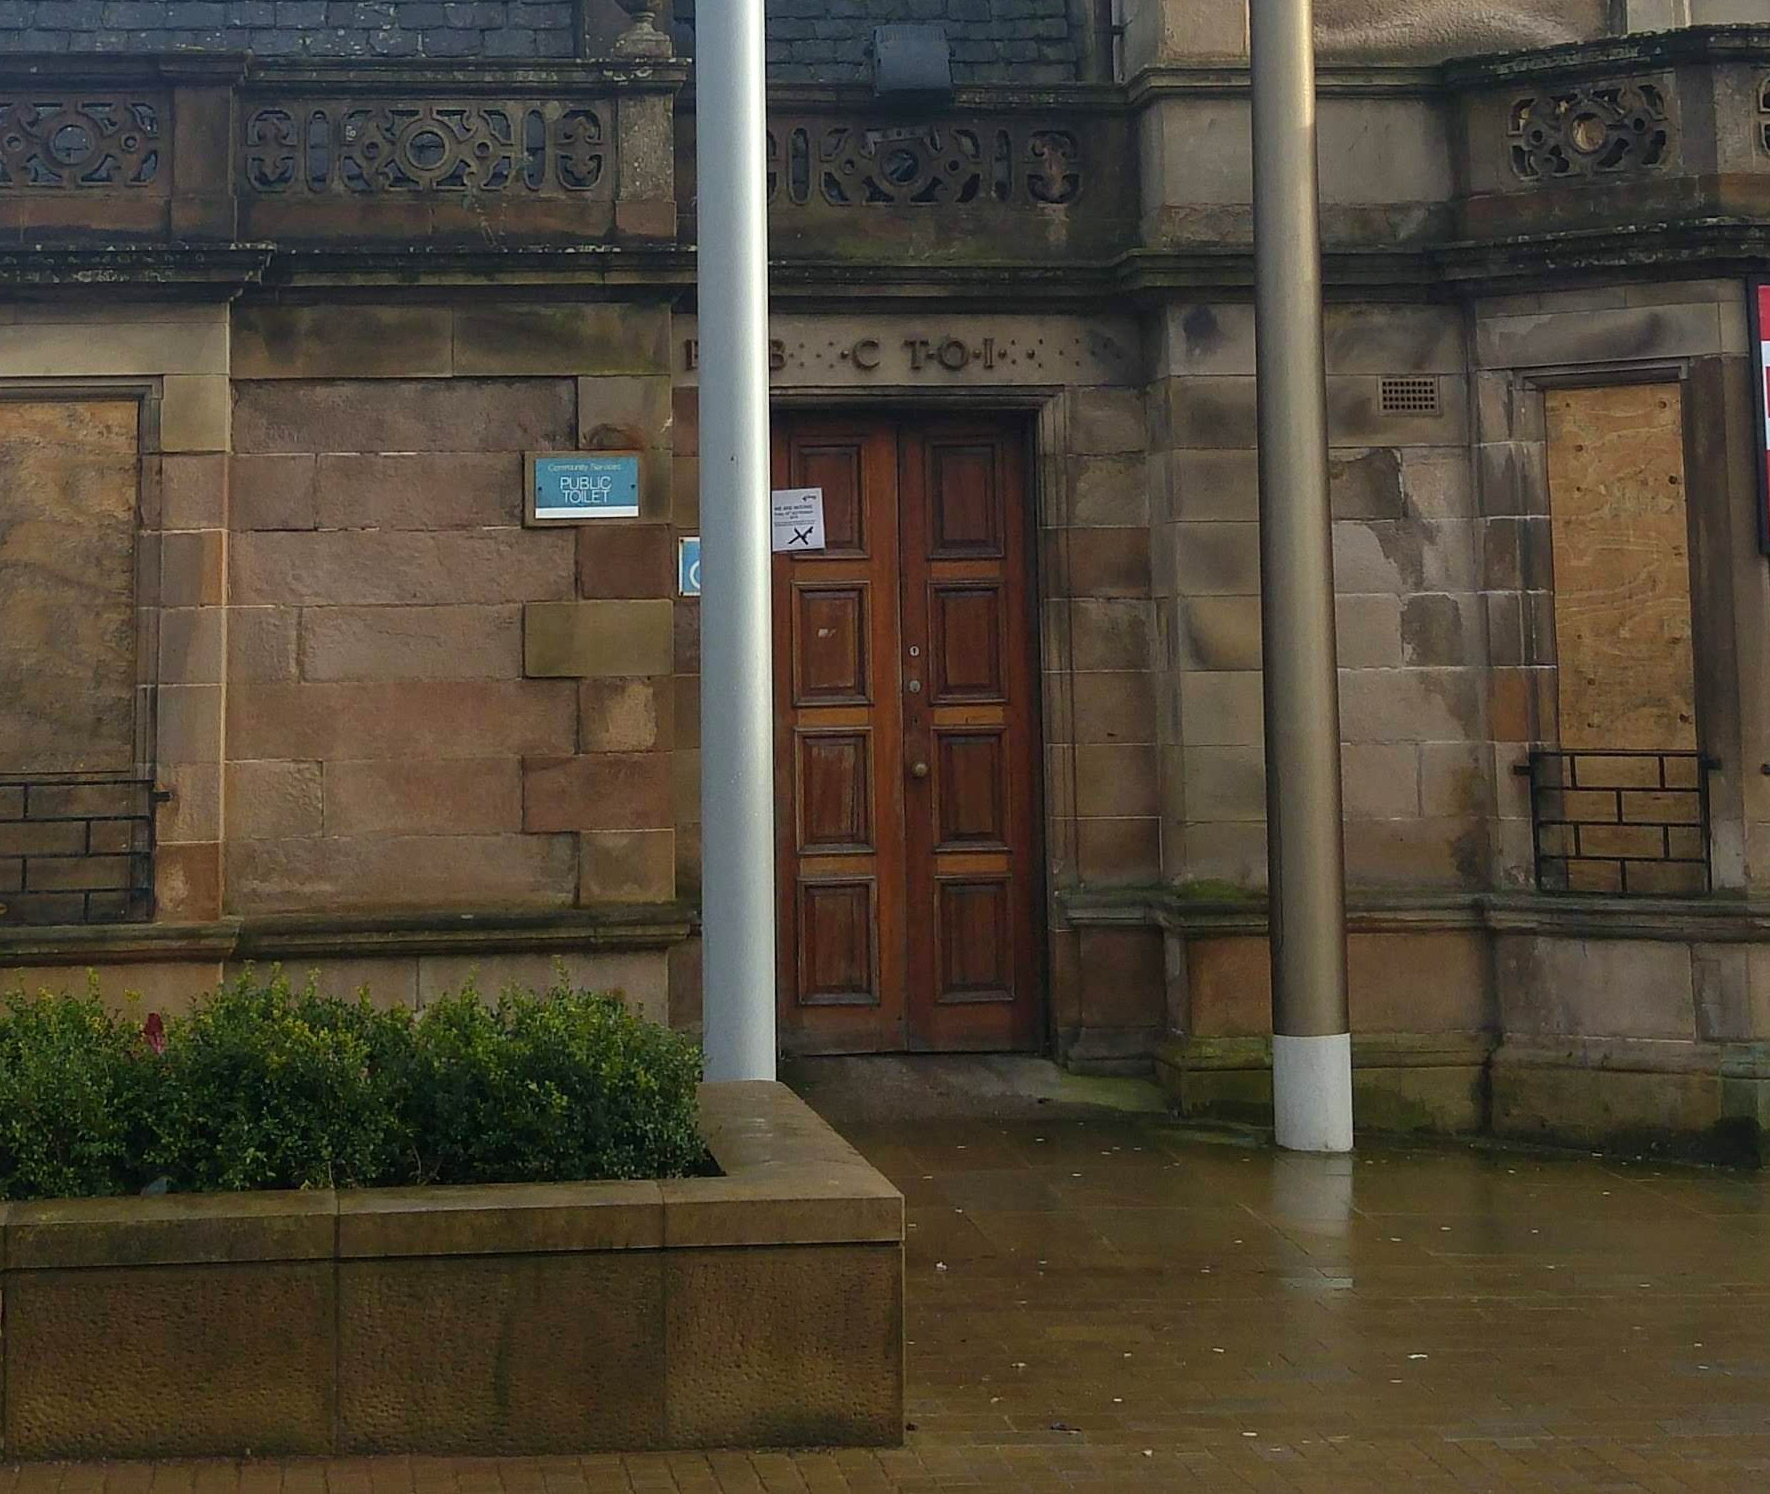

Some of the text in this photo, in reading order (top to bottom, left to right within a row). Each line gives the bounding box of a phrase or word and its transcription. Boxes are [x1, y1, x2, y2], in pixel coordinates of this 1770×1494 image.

[548, 463, 589, 473] Community
[560, 475, 612, 491] PUBLIC
[562, 489, 610, 504] TOILET
